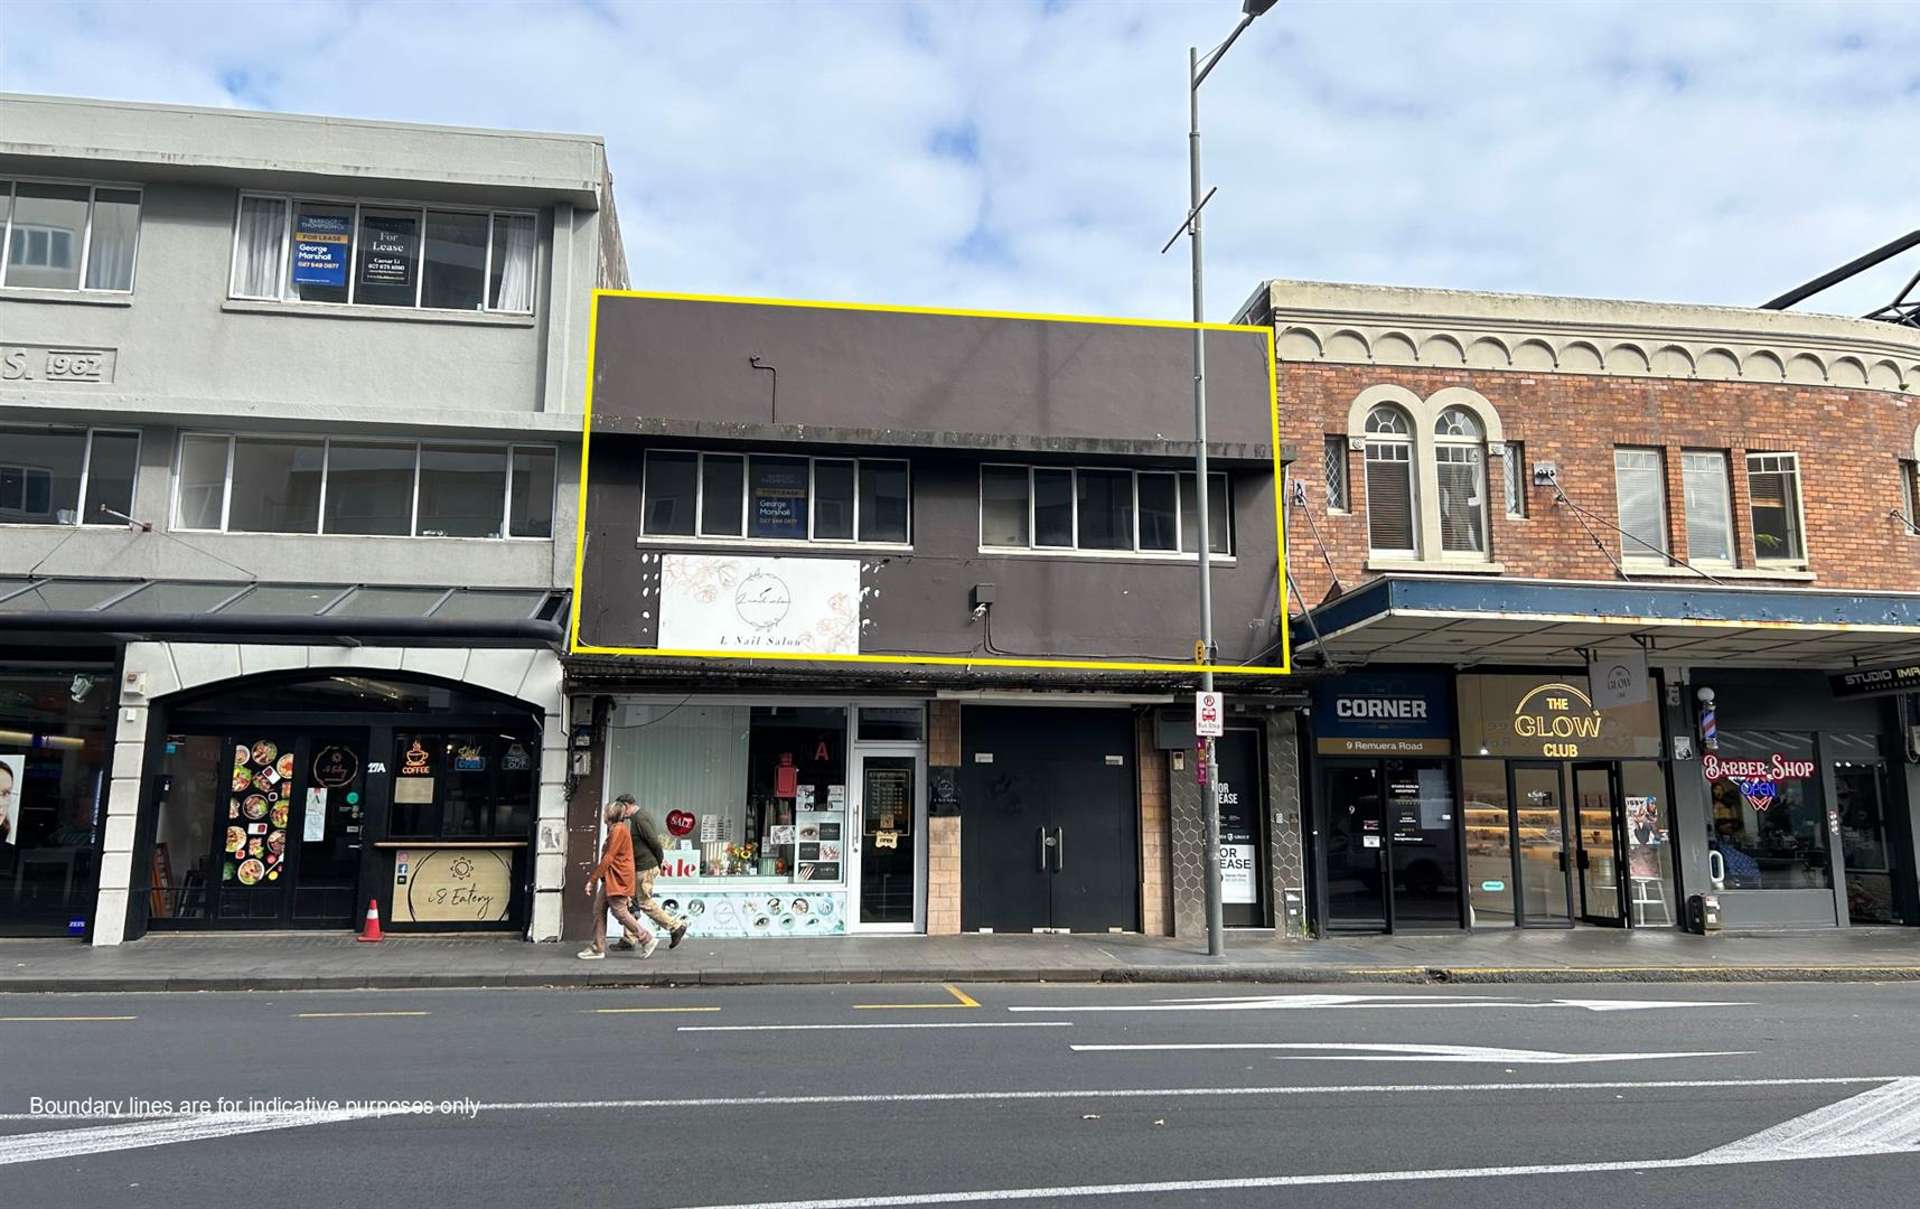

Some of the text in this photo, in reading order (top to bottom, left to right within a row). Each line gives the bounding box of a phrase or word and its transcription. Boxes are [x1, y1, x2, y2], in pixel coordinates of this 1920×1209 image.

[319, 234, 342, 242] LEASE
[380, 231, 399, 242] For
[299, 243, 327, 254] George
[372, 241, 405, 252] Lease
[298, 252, 332, 261] Marshall
[46, 355, 101, 375] 1962
[759, 499, 786, 509] George
[719, 635, 801, 647] L Nail Salon
[1845, 669, 1892, 685] STUDIO
[1336, 698, 1428, 719] CORNER
[1546, 697, 1569, 710] THE
[1514, 715, 1602, 738] GLOW
[1346, 741, 1424, 750] 9 Remuera Road
[1543, 743, 1579, 758] CLUB
[402, 766, 431, 775] COFFEE
[1218, 782, 1230, 793] OR
[1740, 782, 1777, 797] OPEN
[1218, 793, 1239, 805] EASE
[1348, 805, 1356, 815] 9
[1220, 847, 1238, 858] OR
[660, 858, 697, 878] ale
[1220, 858, 1252, 870] EASE
[451, 882, 495, 921] Eatery
